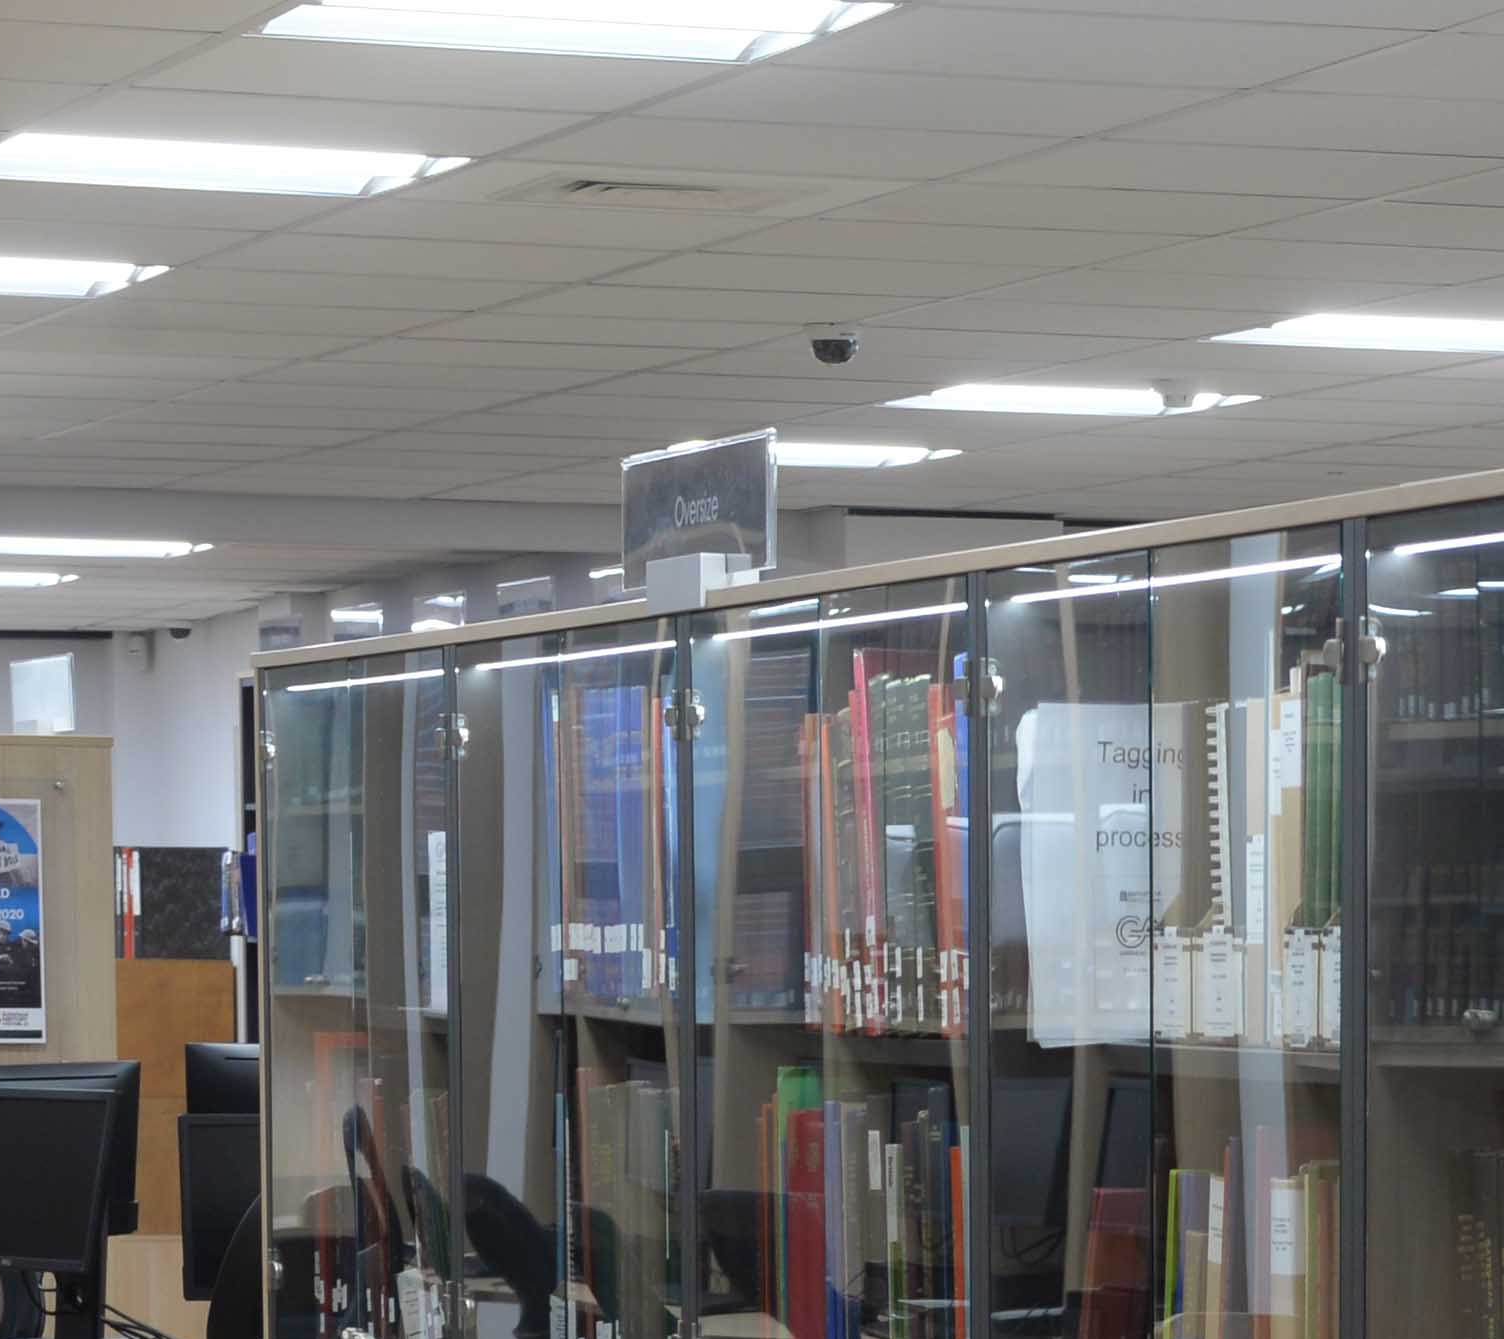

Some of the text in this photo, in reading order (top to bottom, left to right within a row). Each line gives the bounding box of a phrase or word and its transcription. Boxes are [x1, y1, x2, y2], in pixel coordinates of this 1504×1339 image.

[674, 492, 720, 527] Oversize
[1097, 740, 1184, 772] Tagging
[1133, 782, 1151, 804] in
[1096, 828, 1183, 851] process
